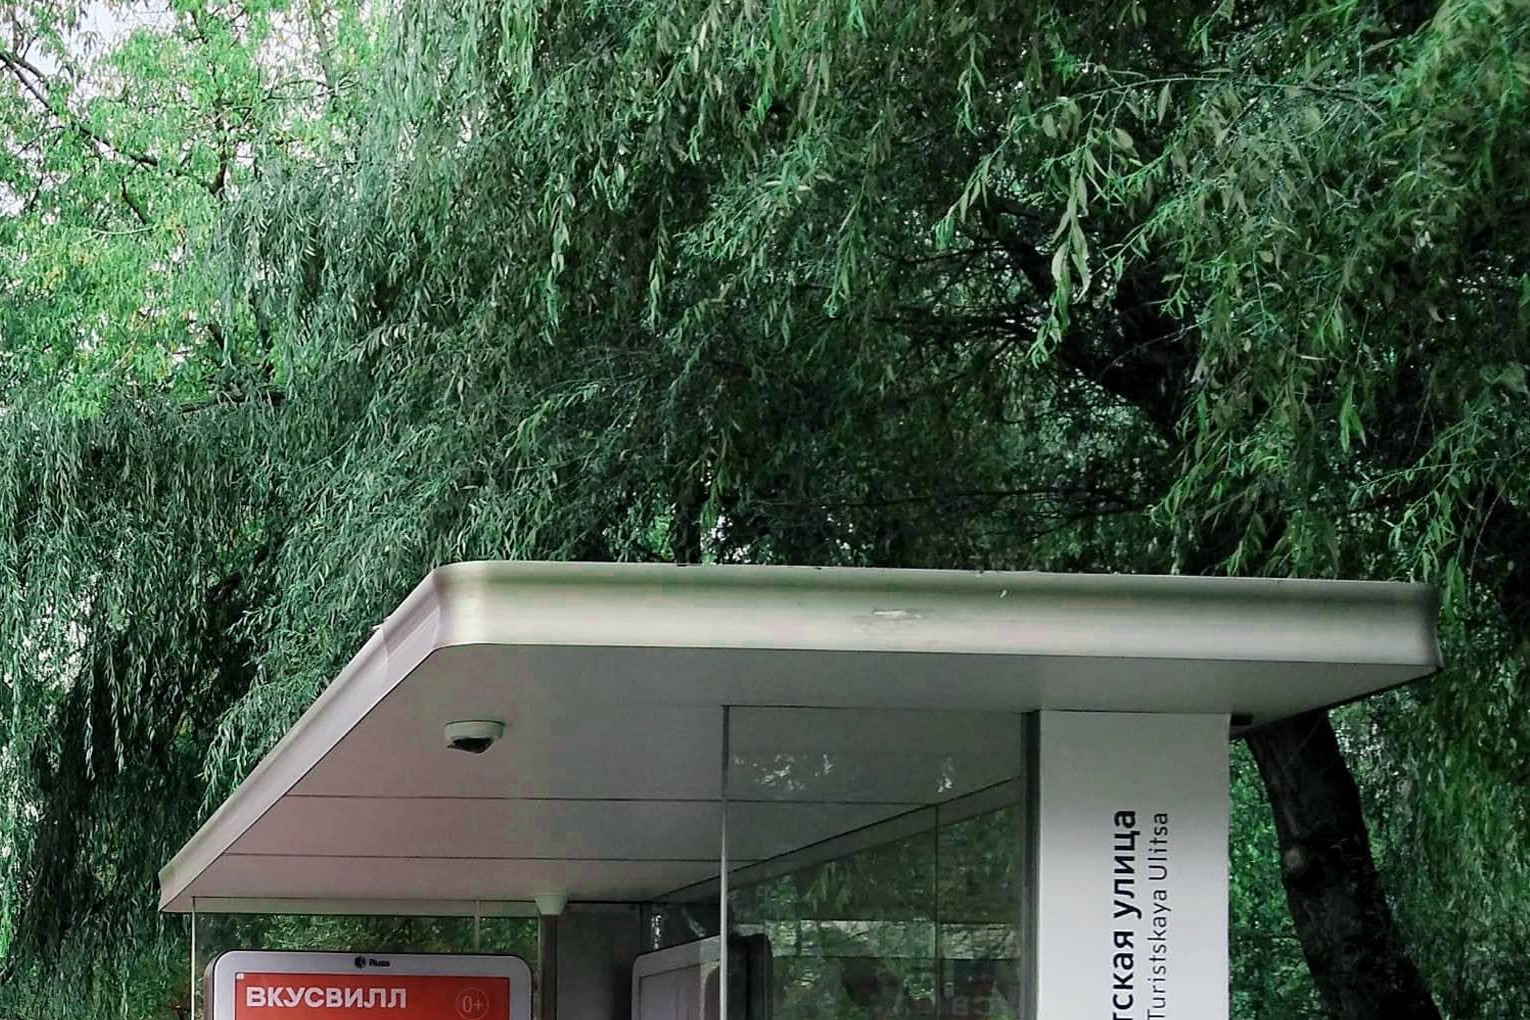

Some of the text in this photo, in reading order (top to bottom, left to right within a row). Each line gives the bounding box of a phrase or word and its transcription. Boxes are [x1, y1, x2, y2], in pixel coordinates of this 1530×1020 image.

[1113, 809, 1142, 920] улица
[1147, 812, 1169, 881] Ulitsa
[246, 986, 407, 1009] ВКУСВИЛЛ
[462, 995, 483, 1014] 0+
